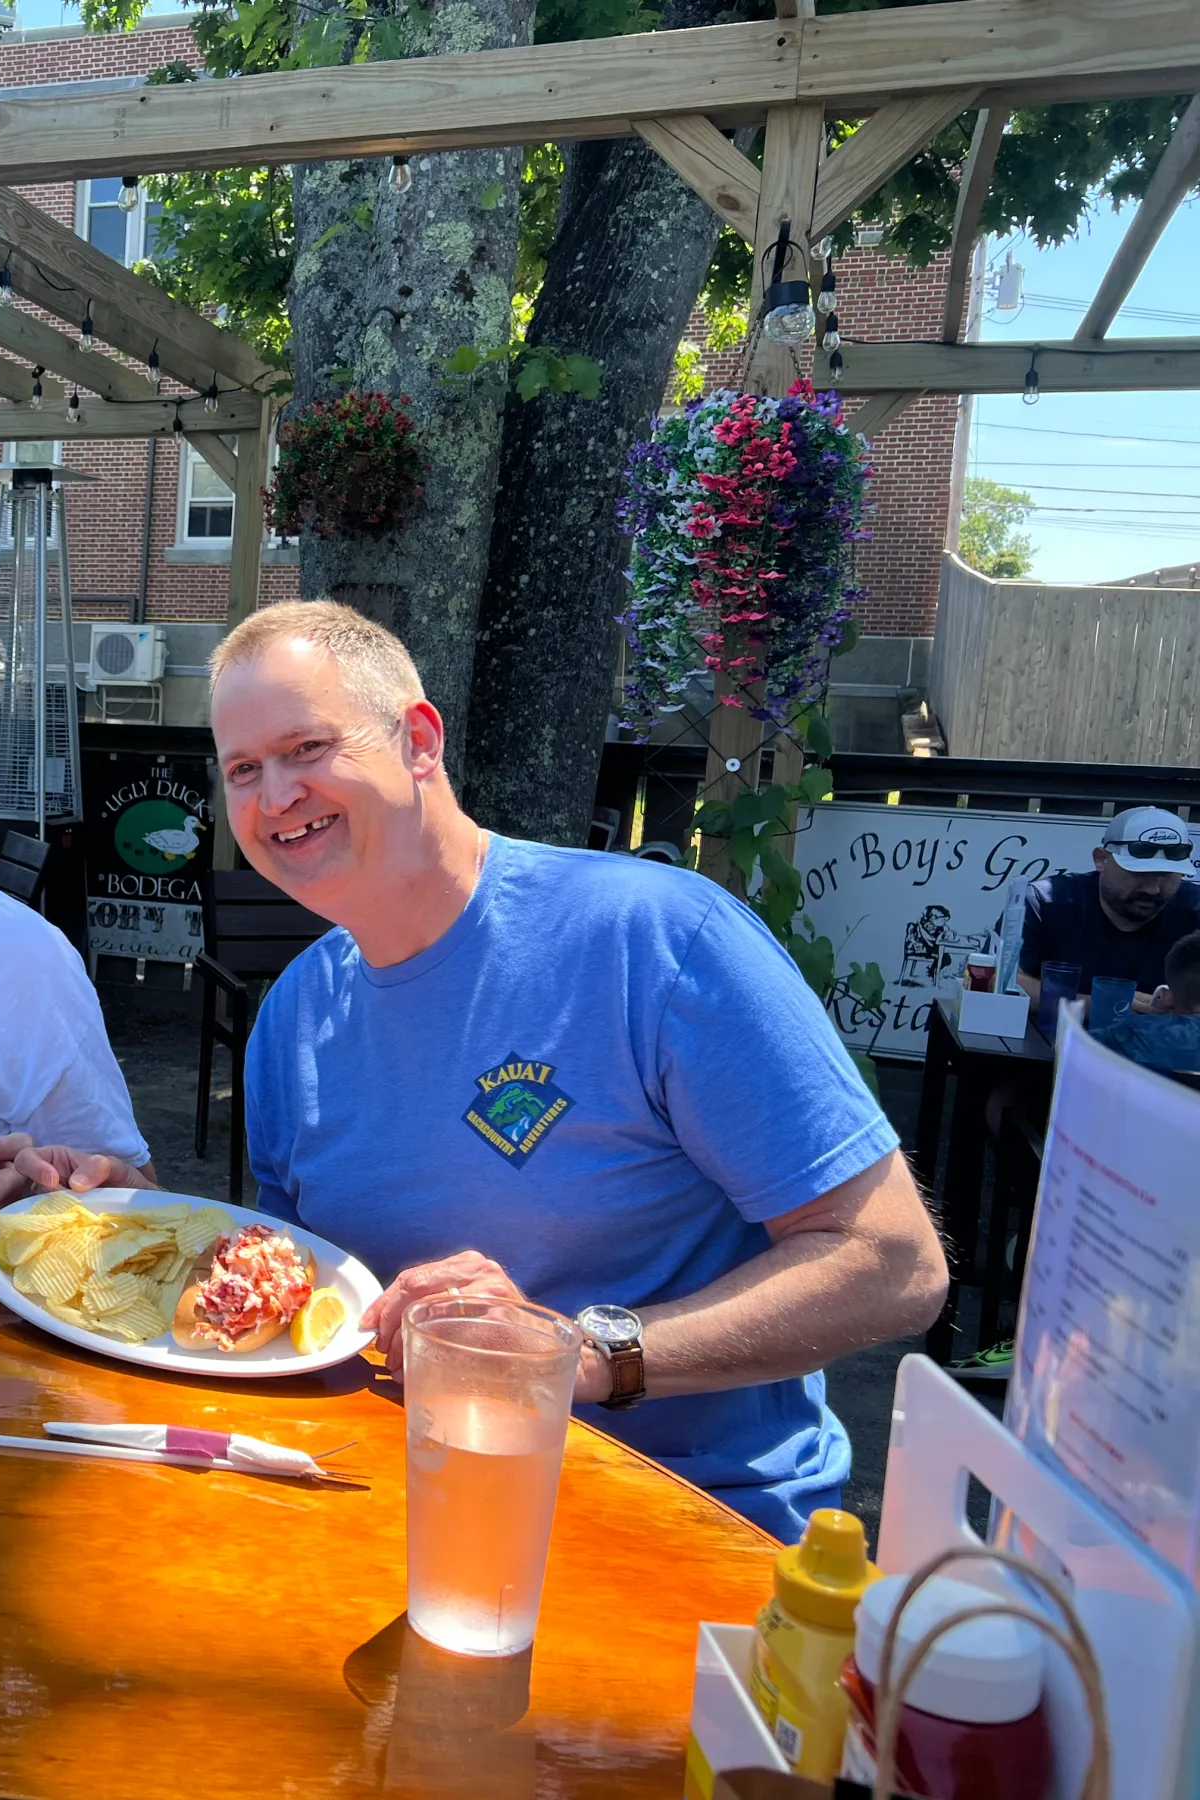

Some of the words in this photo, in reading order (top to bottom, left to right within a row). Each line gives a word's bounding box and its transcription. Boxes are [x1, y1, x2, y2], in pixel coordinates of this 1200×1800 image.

[151, 767, 172, 778] THE
[105, 780, 149, 812] UGLY
[156, 779, 212, 819] DUCK
[849, 819, 969, 887] Boy's
[980, 834, 1071, 891] Go
[107, 873, 203, 901] BODEGA
[478, 1062, 552, 1094] KAUA'I
[466, 1110, 517, 1157] BACKCOUNTRY
[518, 1097, 568, 1154] ADVENTURES
